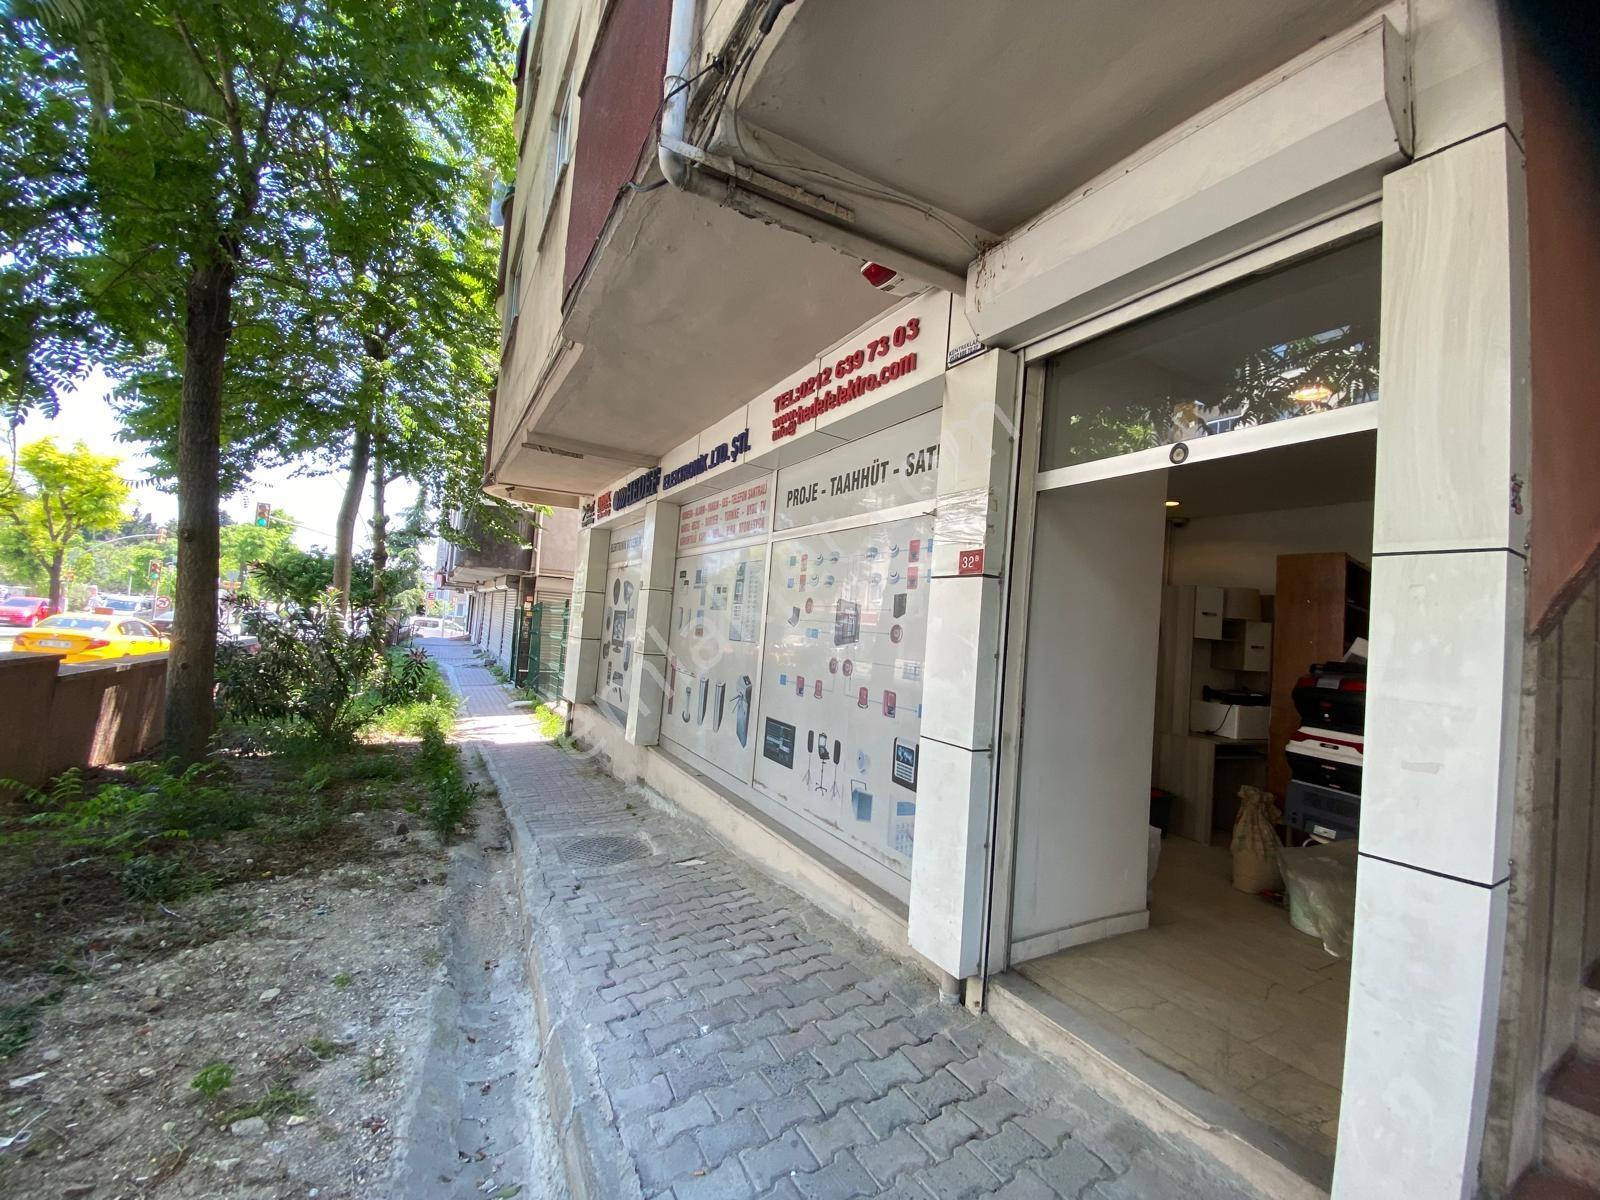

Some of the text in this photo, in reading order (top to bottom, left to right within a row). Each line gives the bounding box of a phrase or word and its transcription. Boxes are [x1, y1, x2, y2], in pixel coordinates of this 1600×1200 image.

[835, 349, 865, 379] 639
[867, 335, 890, 363] 73
[892, 317, 920, 348] 03
[786, 482, 819, 508] PROJE
[830, 458, 890, 497] TAAHHÜT
